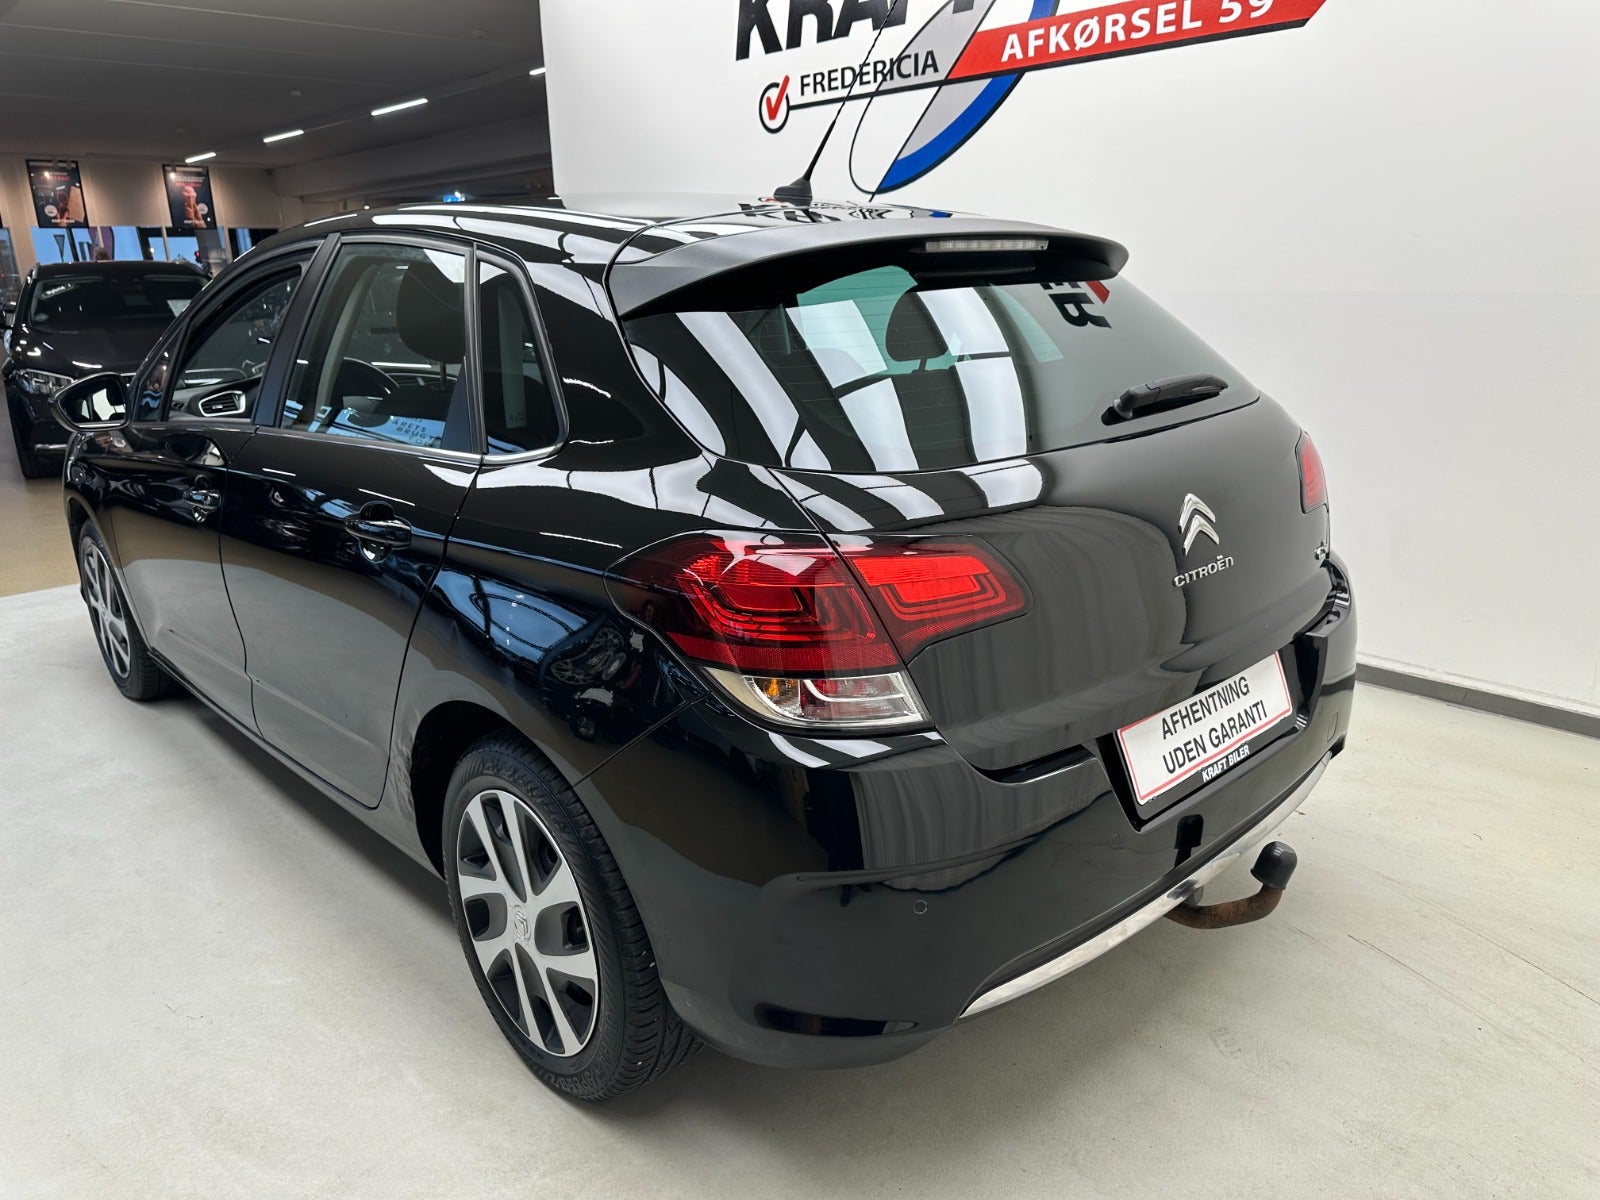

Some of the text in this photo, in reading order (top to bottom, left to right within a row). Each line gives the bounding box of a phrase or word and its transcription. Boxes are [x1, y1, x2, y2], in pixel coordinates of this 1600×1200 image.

[735, 0, 975, 61] KRA
[1000, 0, 1203, 62] AFKØRSEL
[800, 50, 939, 96] FREDERICIA
[1172, 555, 1234, 587] CITROËN
[1161, 676, 1250, 740] AFHENTNING
[1162, 700, 1268, 774] UDEN GARANTI
[1201, 745, 1250, 783] KRAFT BILER
